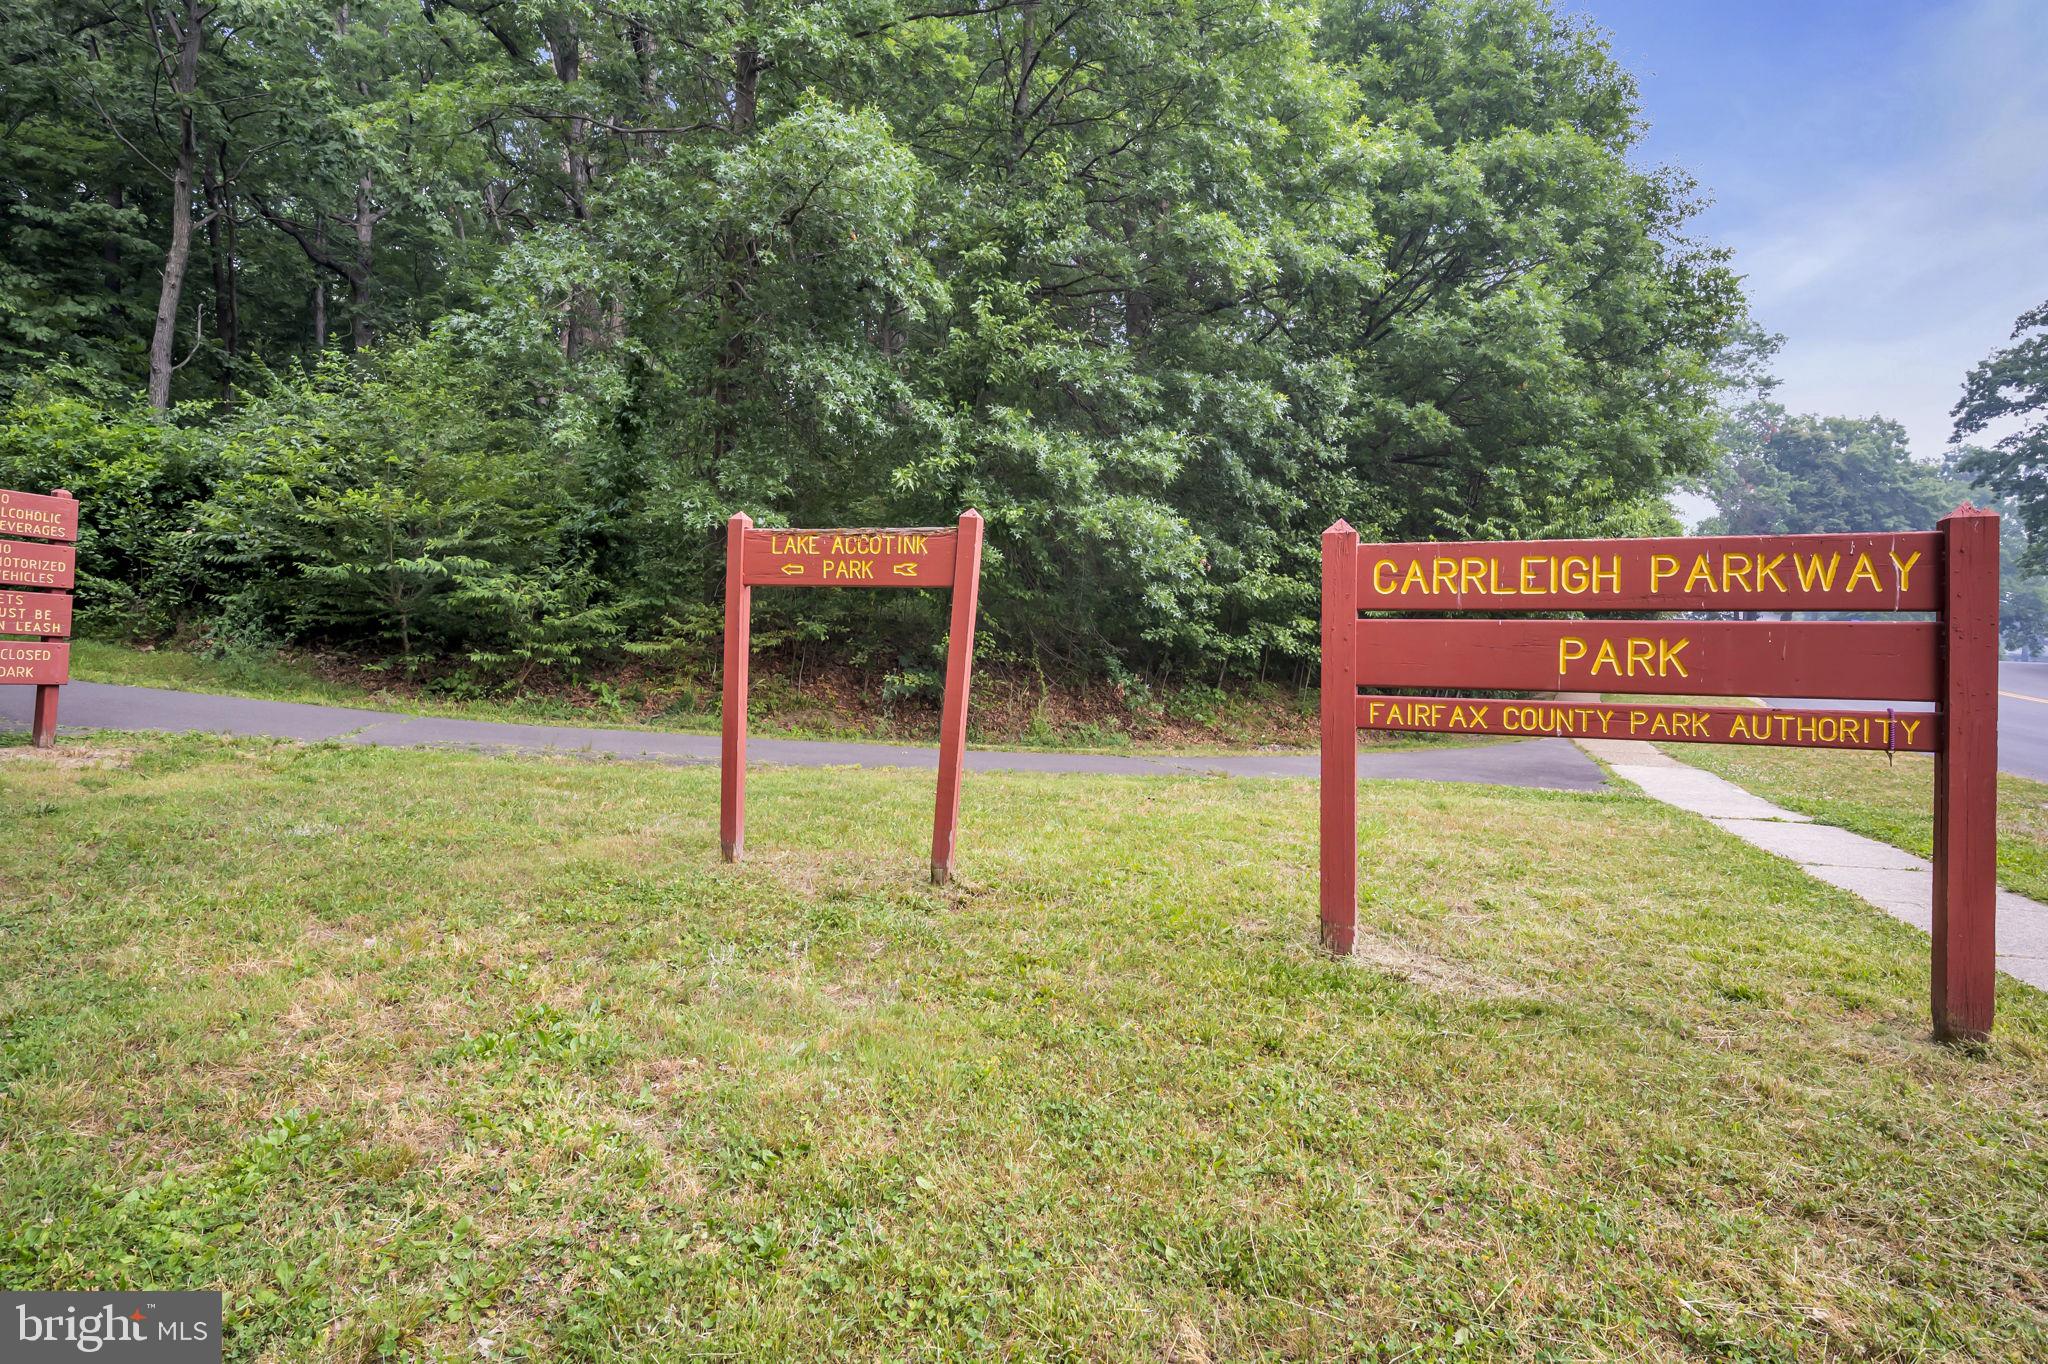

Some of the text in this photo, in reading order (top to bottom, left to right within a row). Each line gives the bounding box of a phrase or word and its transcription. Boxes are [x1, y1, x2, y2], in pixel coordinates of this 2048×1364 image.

[1, 493, 9, 504] O
[0, 507, 62, 524] LCOHOLIC
[0, 520, 66, 538] EVERAGES
[771, 534, 929, 556] LAKE ACCOTINK
[822, 559, 874, 579] PARK
[1373, 550, 1922, 595] CARRLEIGH PARKWAY
[0, 570, 55, 584] EHICLES
[0, 593, 24, 605] ETS
[0, 607, 52, 621] UST BE
[0, 620, 61, 633] N LEASH
[0, 648, 51, 661] CLOSED
[1558, 636, 1690, 678] PARK
[0, 666, 34, 678] DARK
[1369, 702, 1921, 745] FAIRFAX COUNTY PARK AUTHORITY
